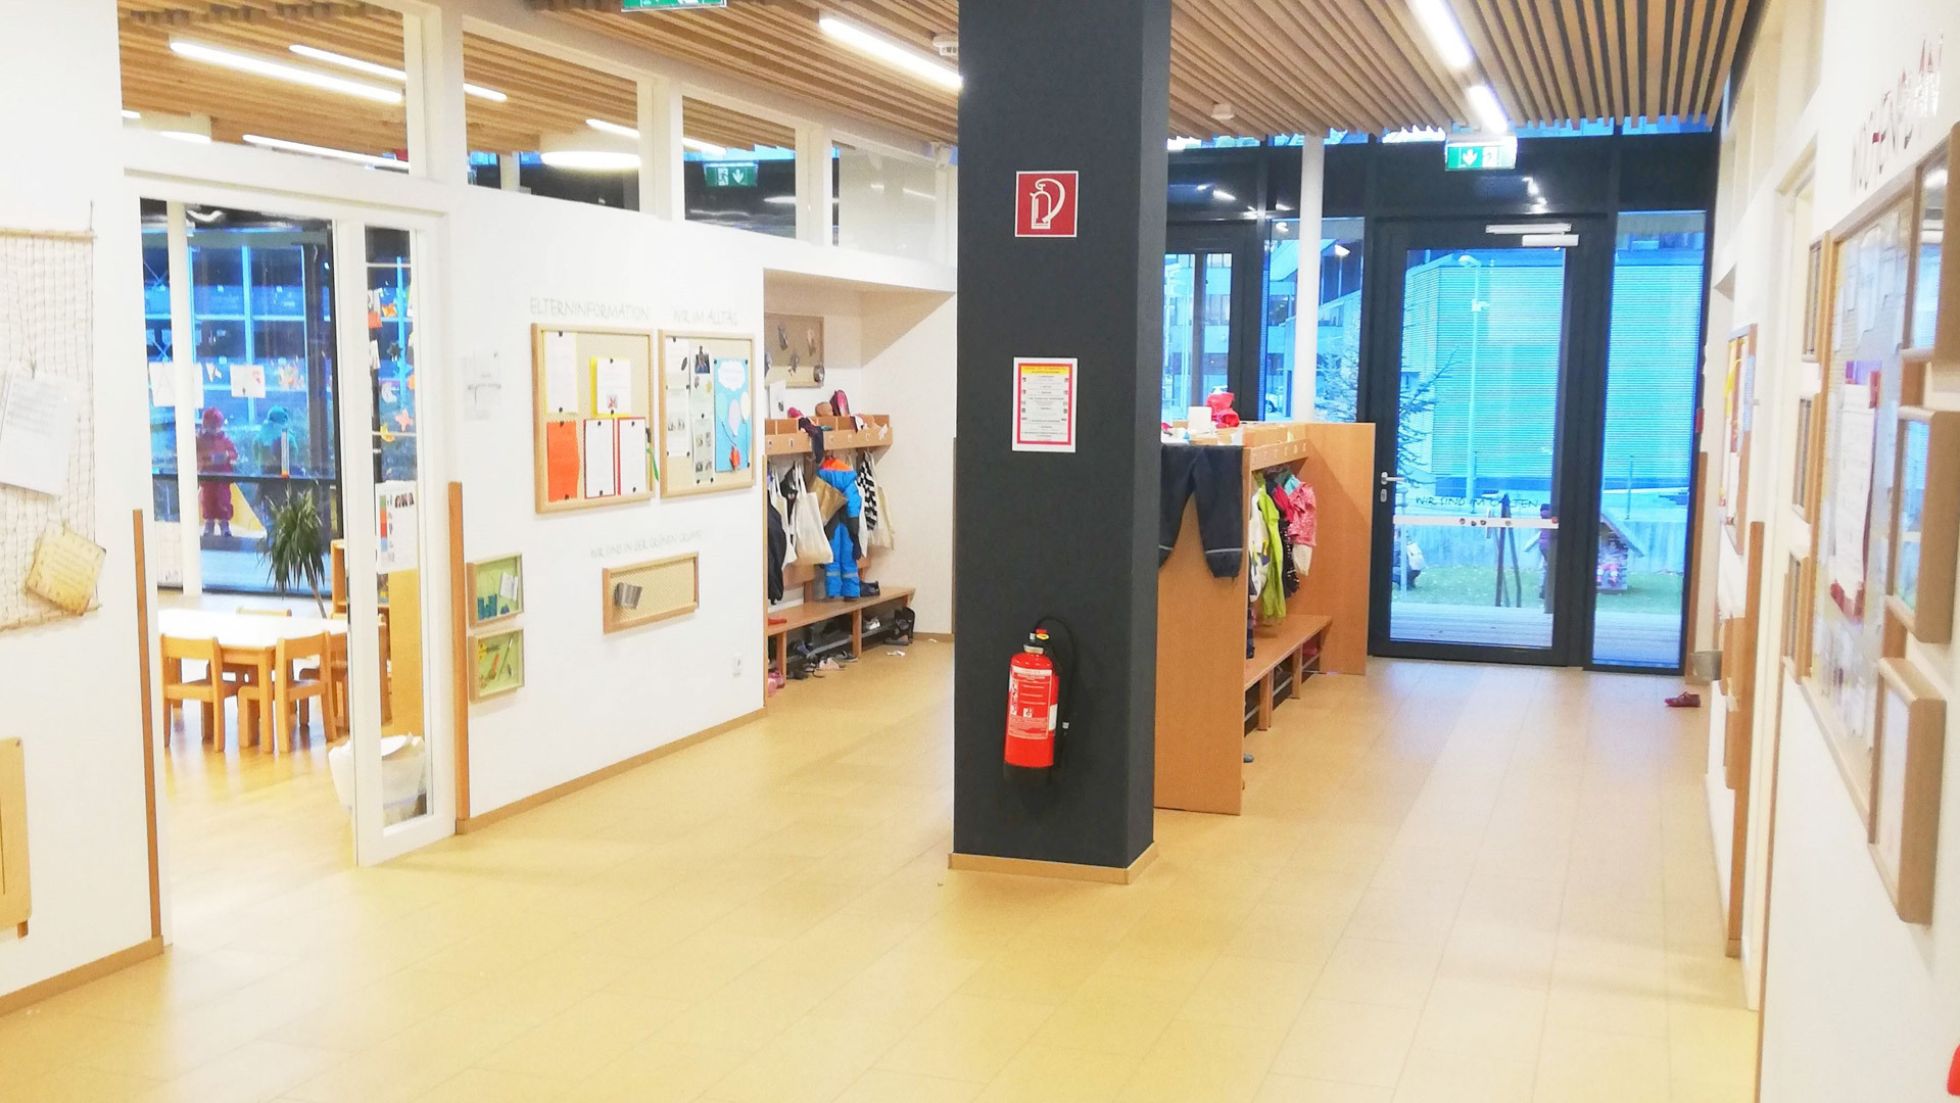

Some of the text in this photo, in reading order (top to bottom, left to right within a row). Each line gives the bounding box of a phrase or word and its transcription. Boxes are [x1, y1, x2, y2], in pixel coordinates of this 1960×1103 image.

[530, 296, 649, 321] ELTERNINFORMATION
[1415, 496, 1437, 506] WIR
[1440, 496, 1465, 506] SIND
